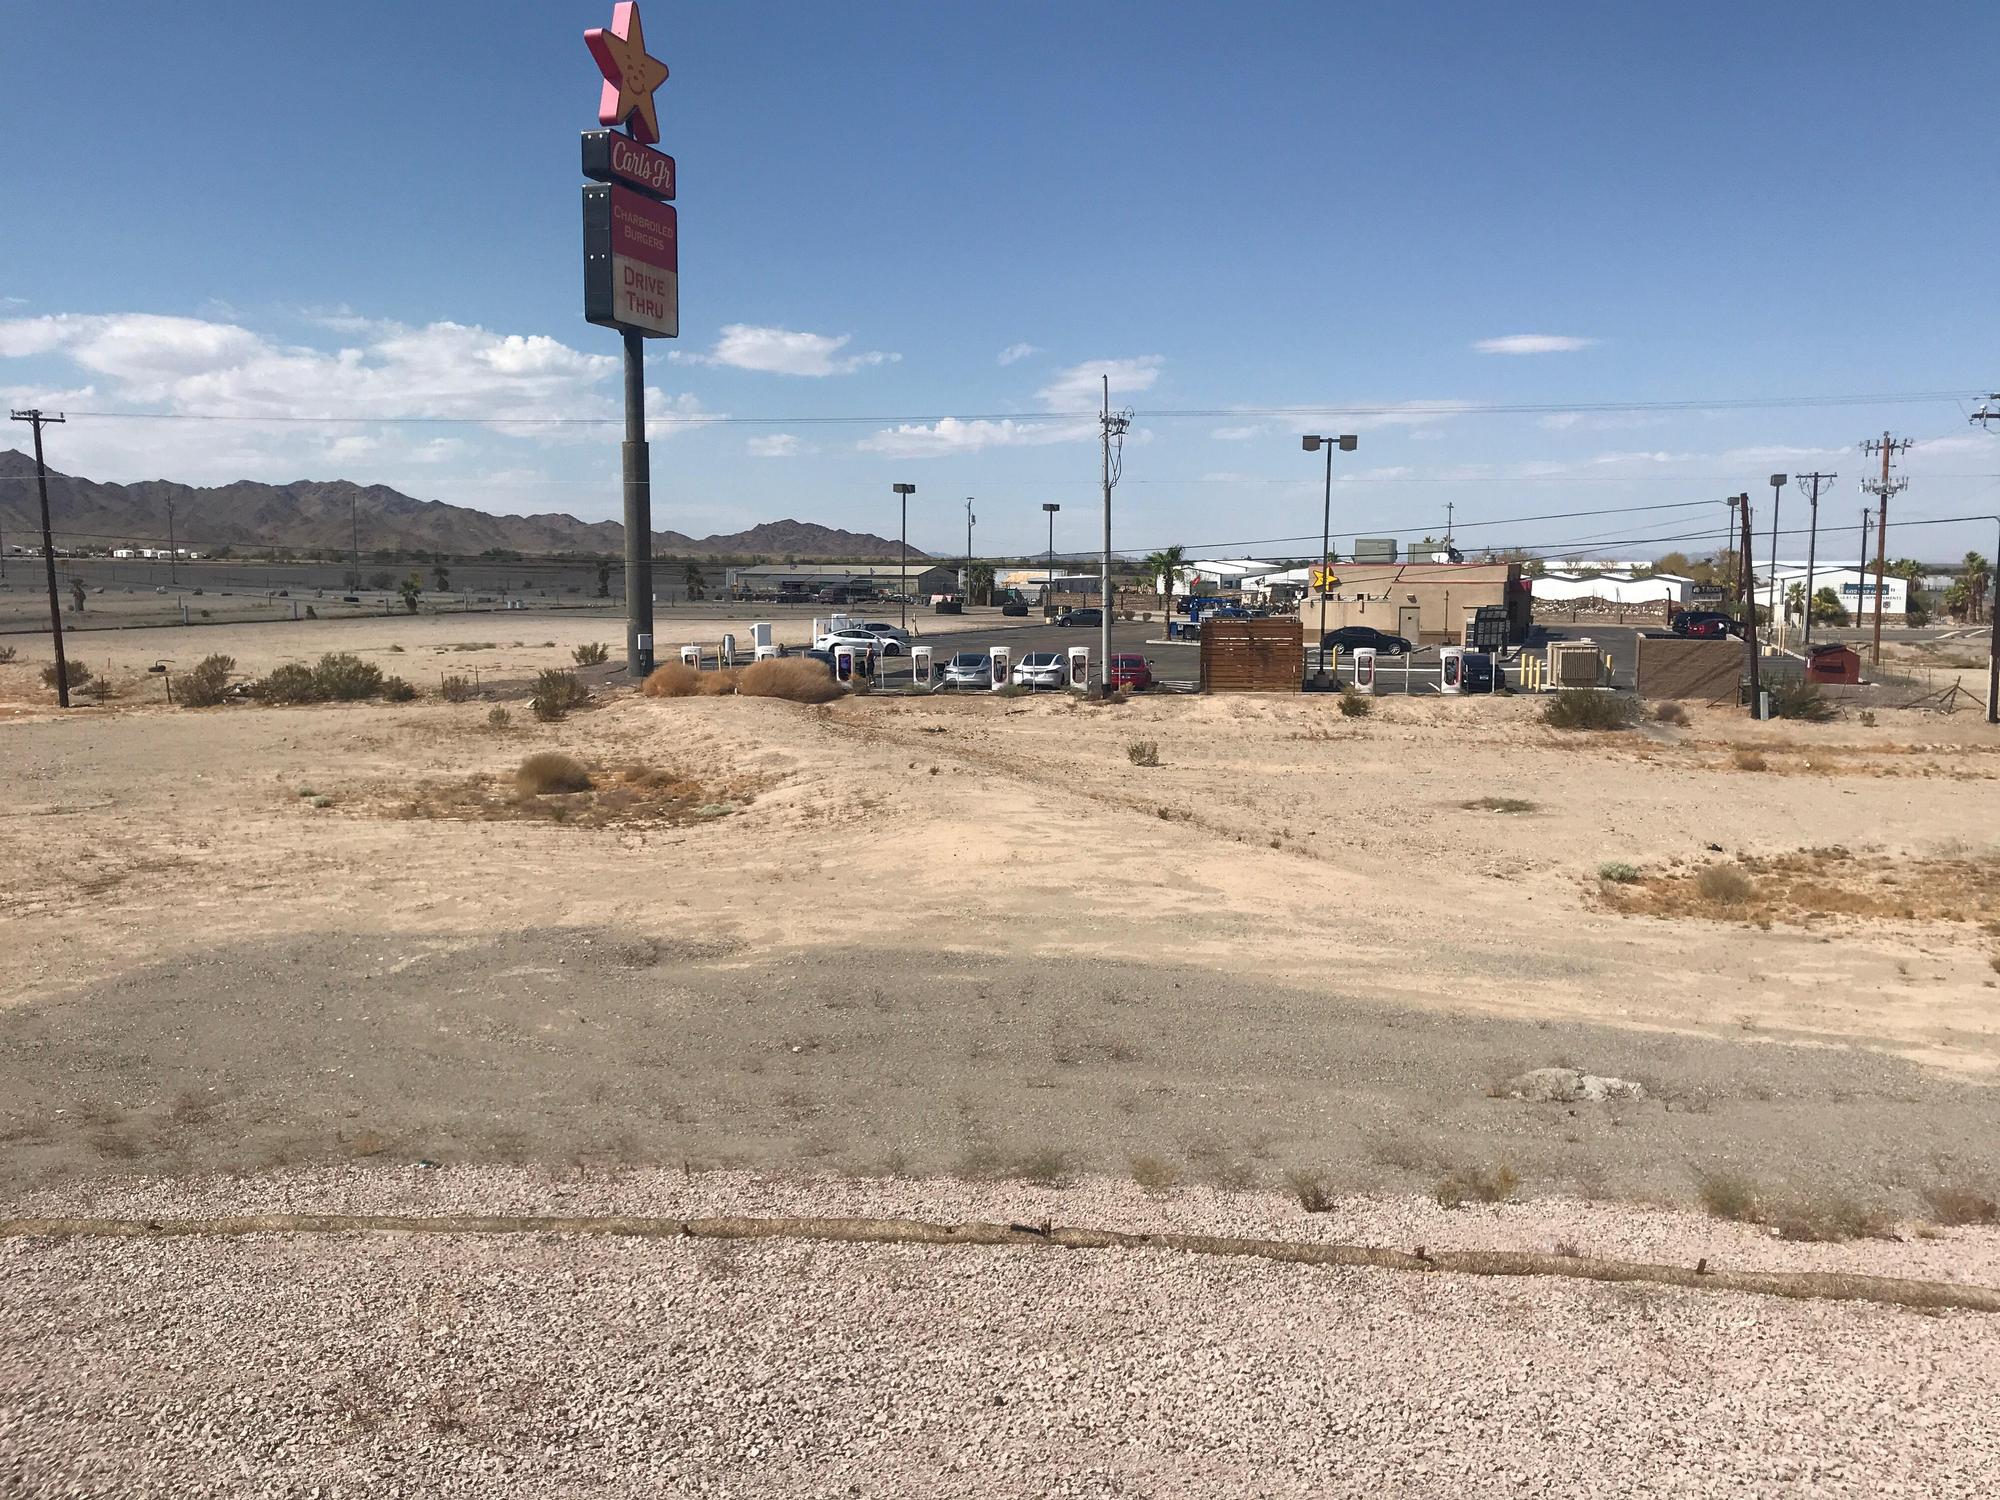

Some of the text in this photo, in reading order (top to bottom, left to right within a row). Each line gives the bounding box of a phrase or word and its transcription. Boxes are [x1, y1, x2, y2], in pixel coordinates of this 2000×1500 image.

[613, 141, 652, 179] Carl's
[614, 205, 673, 238] CHARBROILED
[624, 225, 665, 250] BURGERS
[624, 265, 665, 296] DRIVE
[626, 290, 664, 320] THRU
